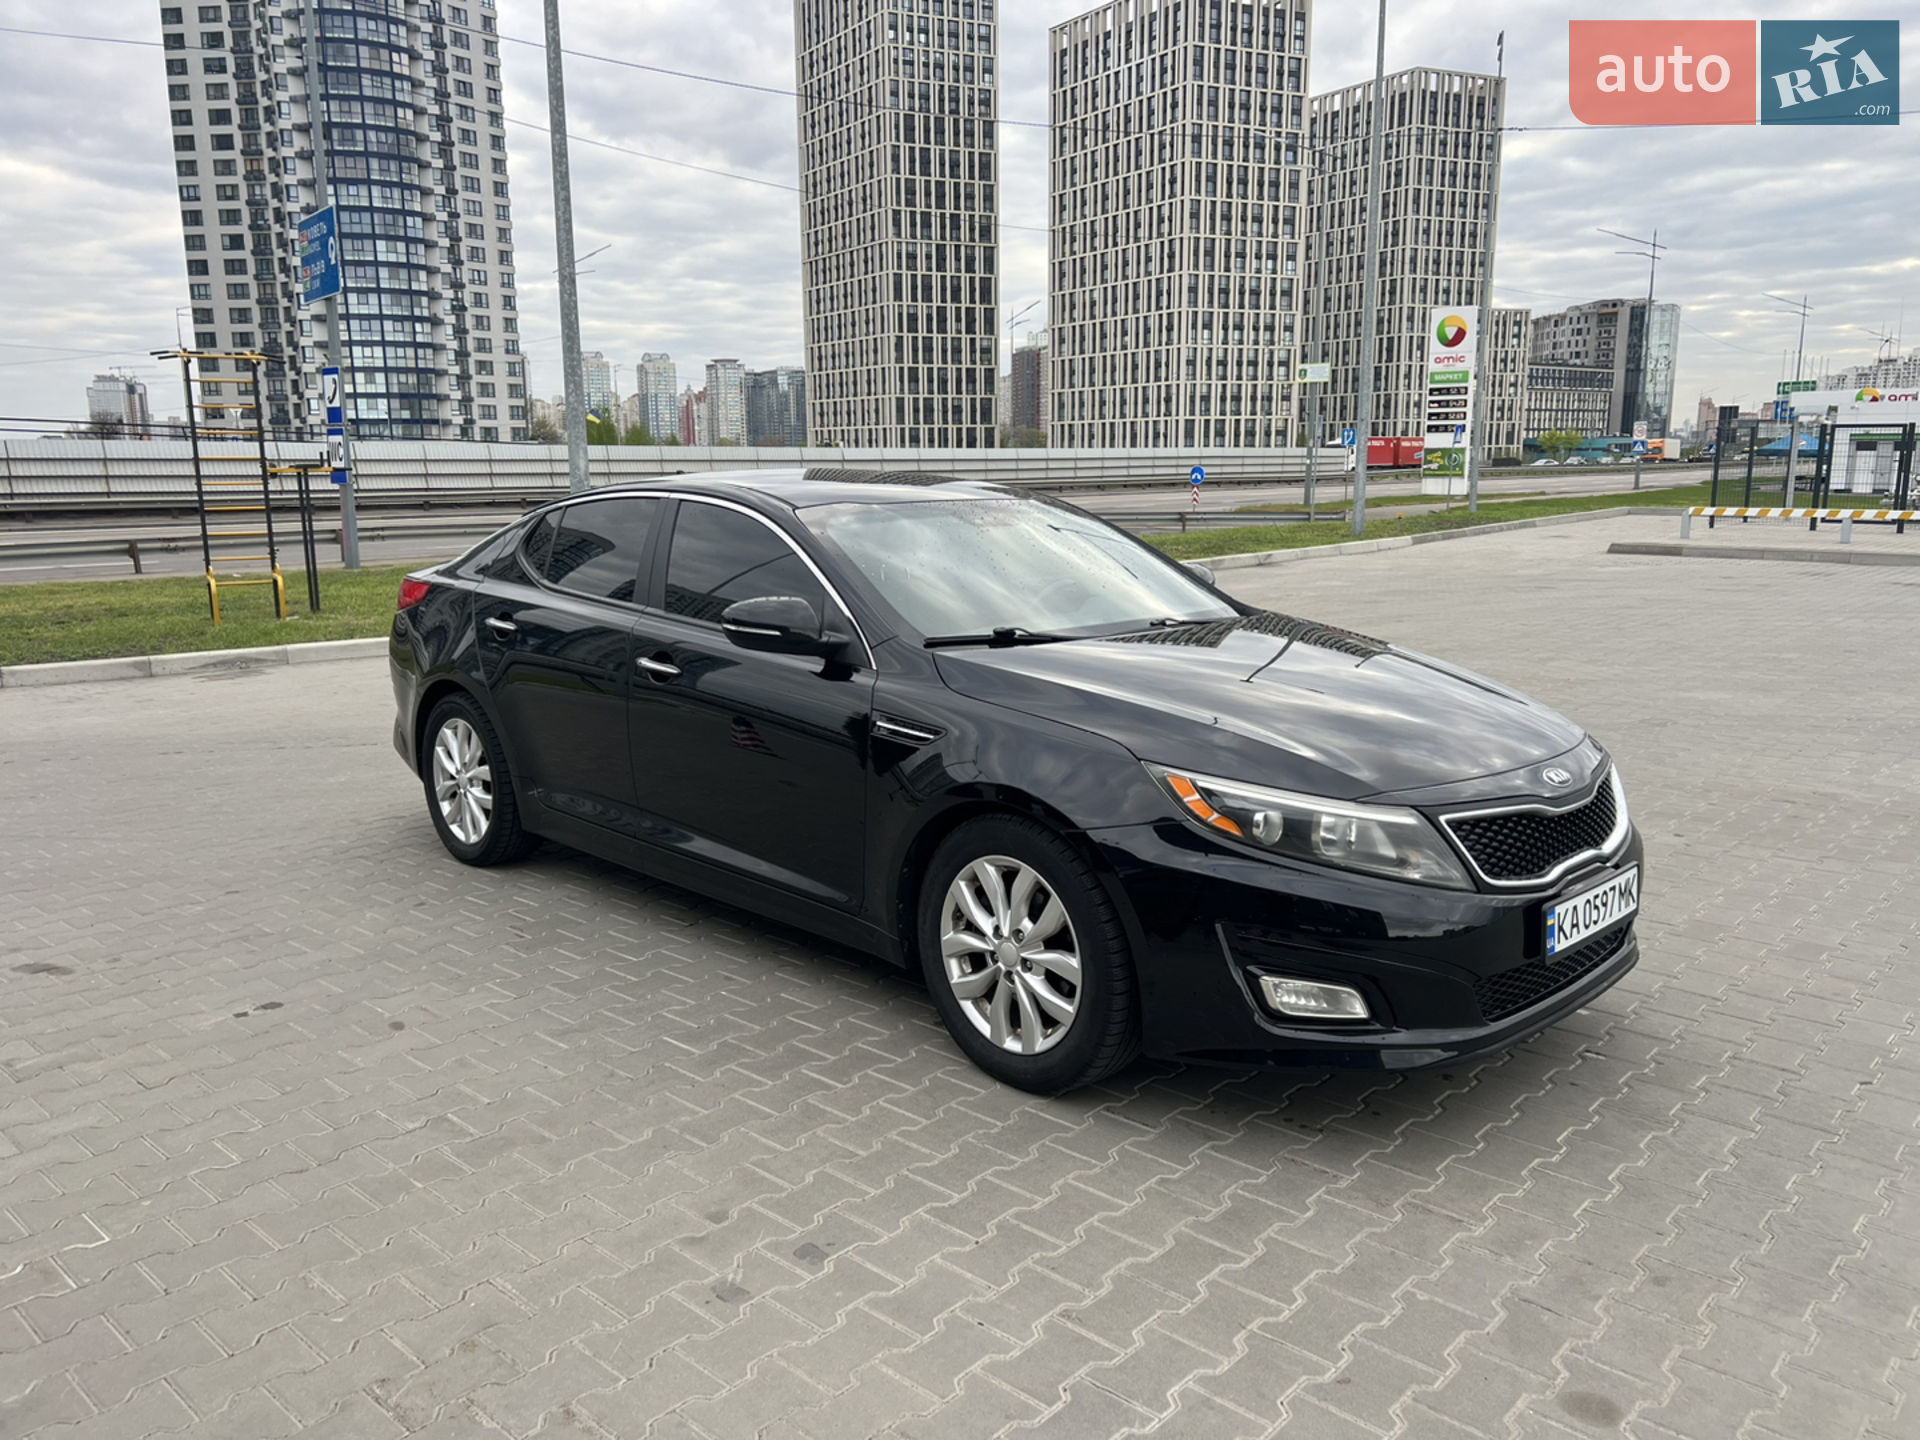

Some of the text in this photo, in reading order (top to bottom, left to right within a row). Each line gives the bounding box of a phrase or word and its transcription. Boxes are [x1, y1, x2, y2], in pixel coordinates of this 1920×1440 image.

[1434, 353, 1466, 364] amic
[329, 441, 343, 461] WC
[1545, 769, 1571, 785] KIA
[1557, 873, 1636, 944] KA 0597 MK
